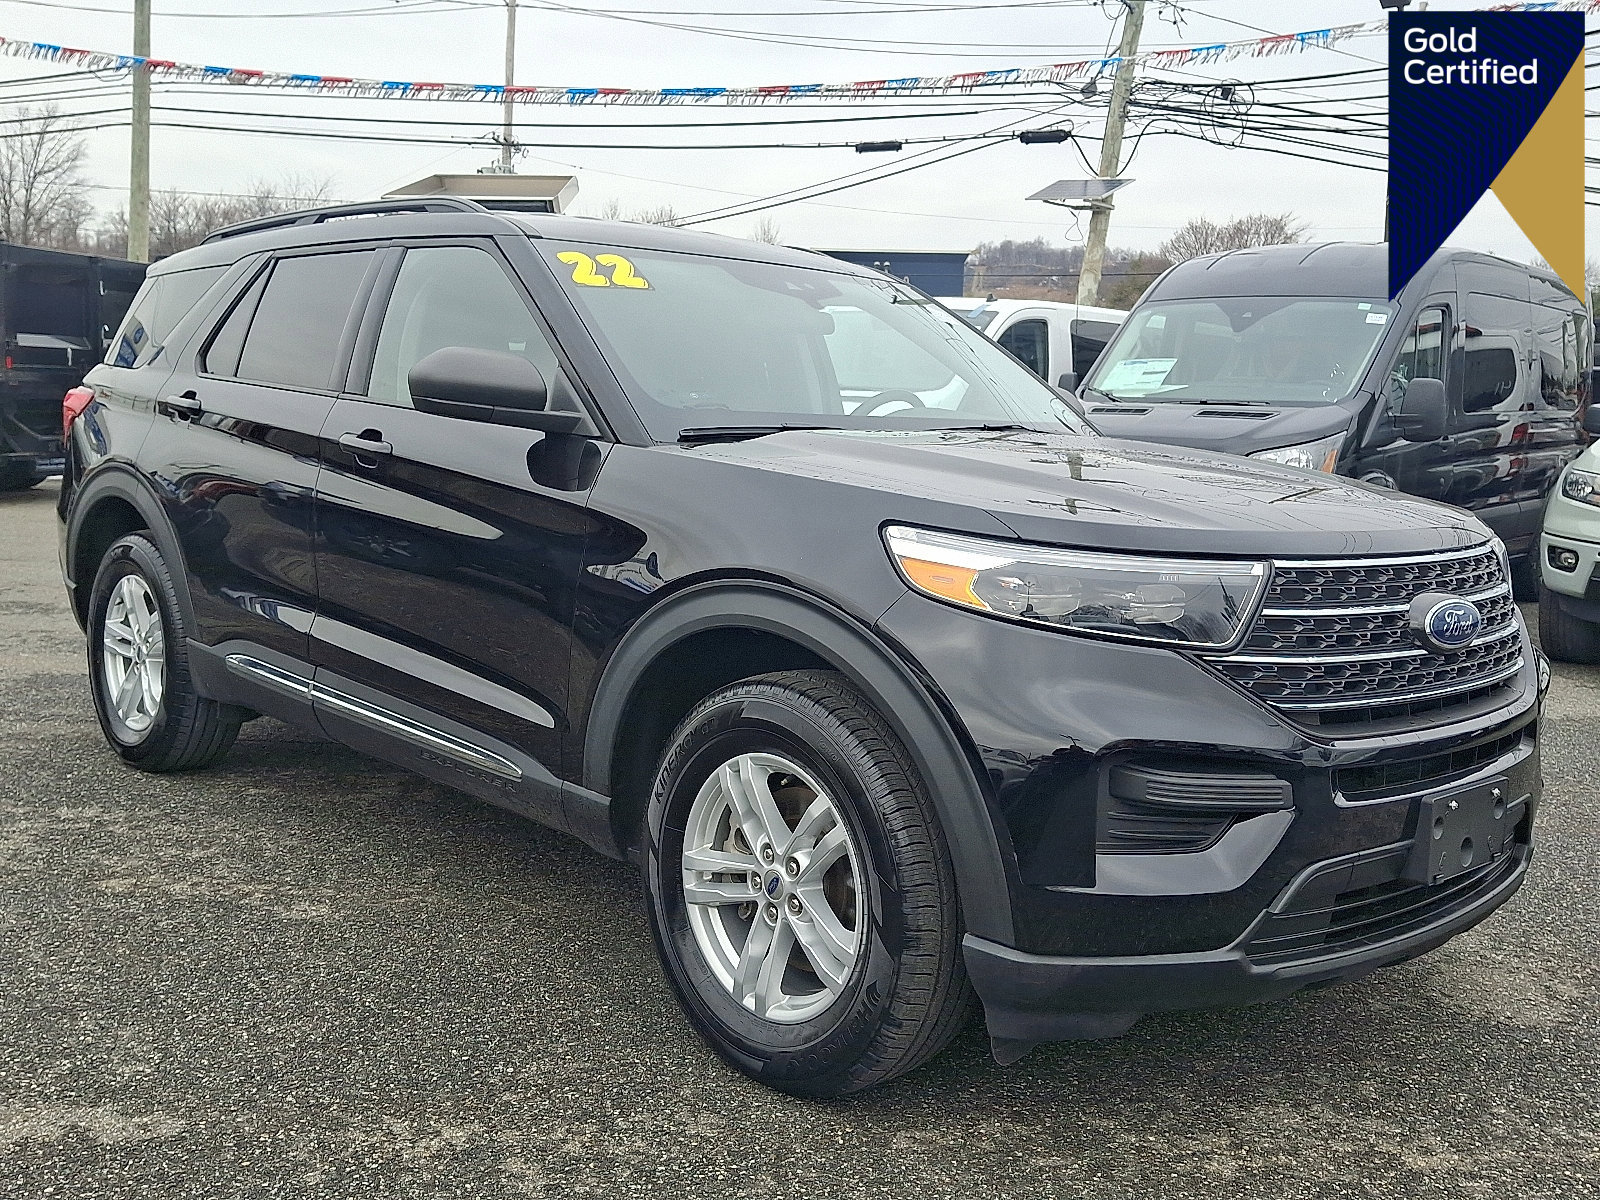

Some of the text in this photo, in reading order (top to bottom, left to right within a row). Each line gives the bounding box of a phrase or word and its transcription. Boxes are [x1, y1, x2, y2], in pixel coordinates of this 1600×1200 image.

[556, 251, 649, 289] 22
[1444, 609, 1473, 637] Ford
[419, 749, 517, 793] EXPLORER
